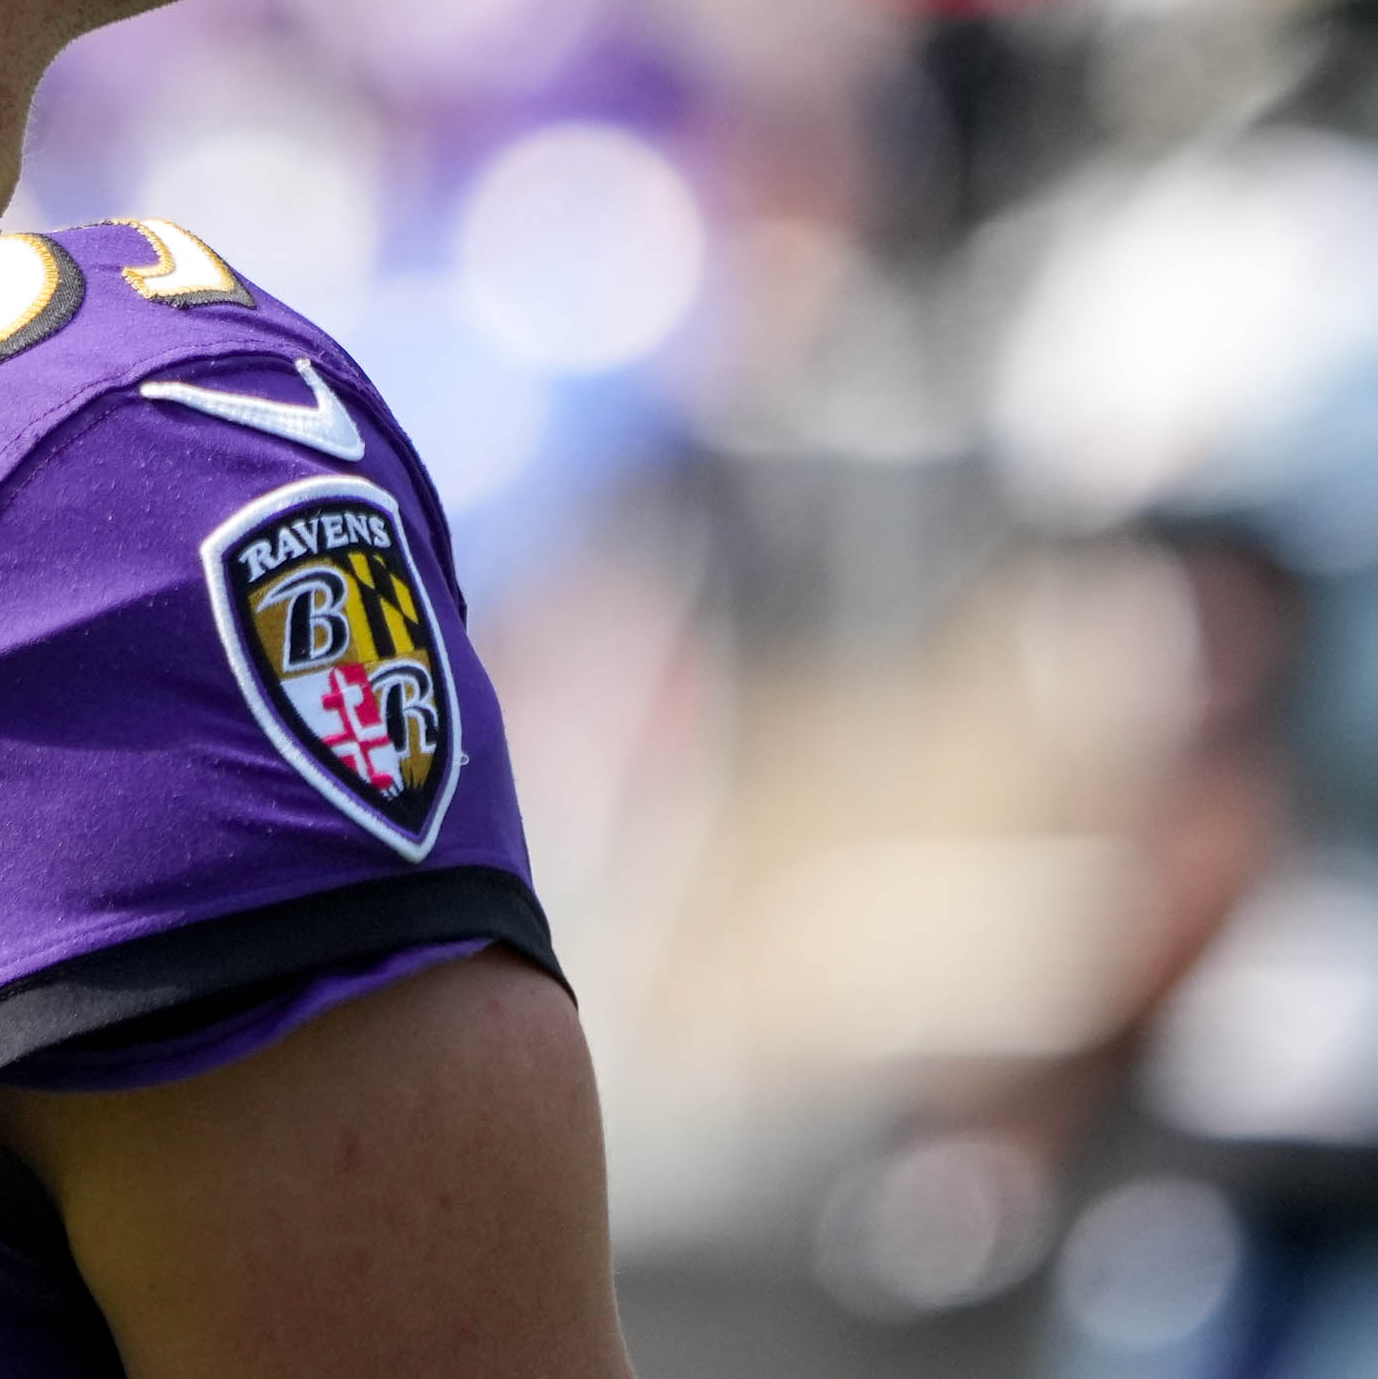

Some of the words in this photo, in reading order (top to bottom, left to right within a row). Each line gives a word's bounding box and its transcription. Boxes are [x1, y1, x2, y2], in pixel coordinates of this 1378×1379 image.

[237, 512, 392, 583] RAVENS
[256, 564, 351, 674] B
[369, 658, 440, 759] R
